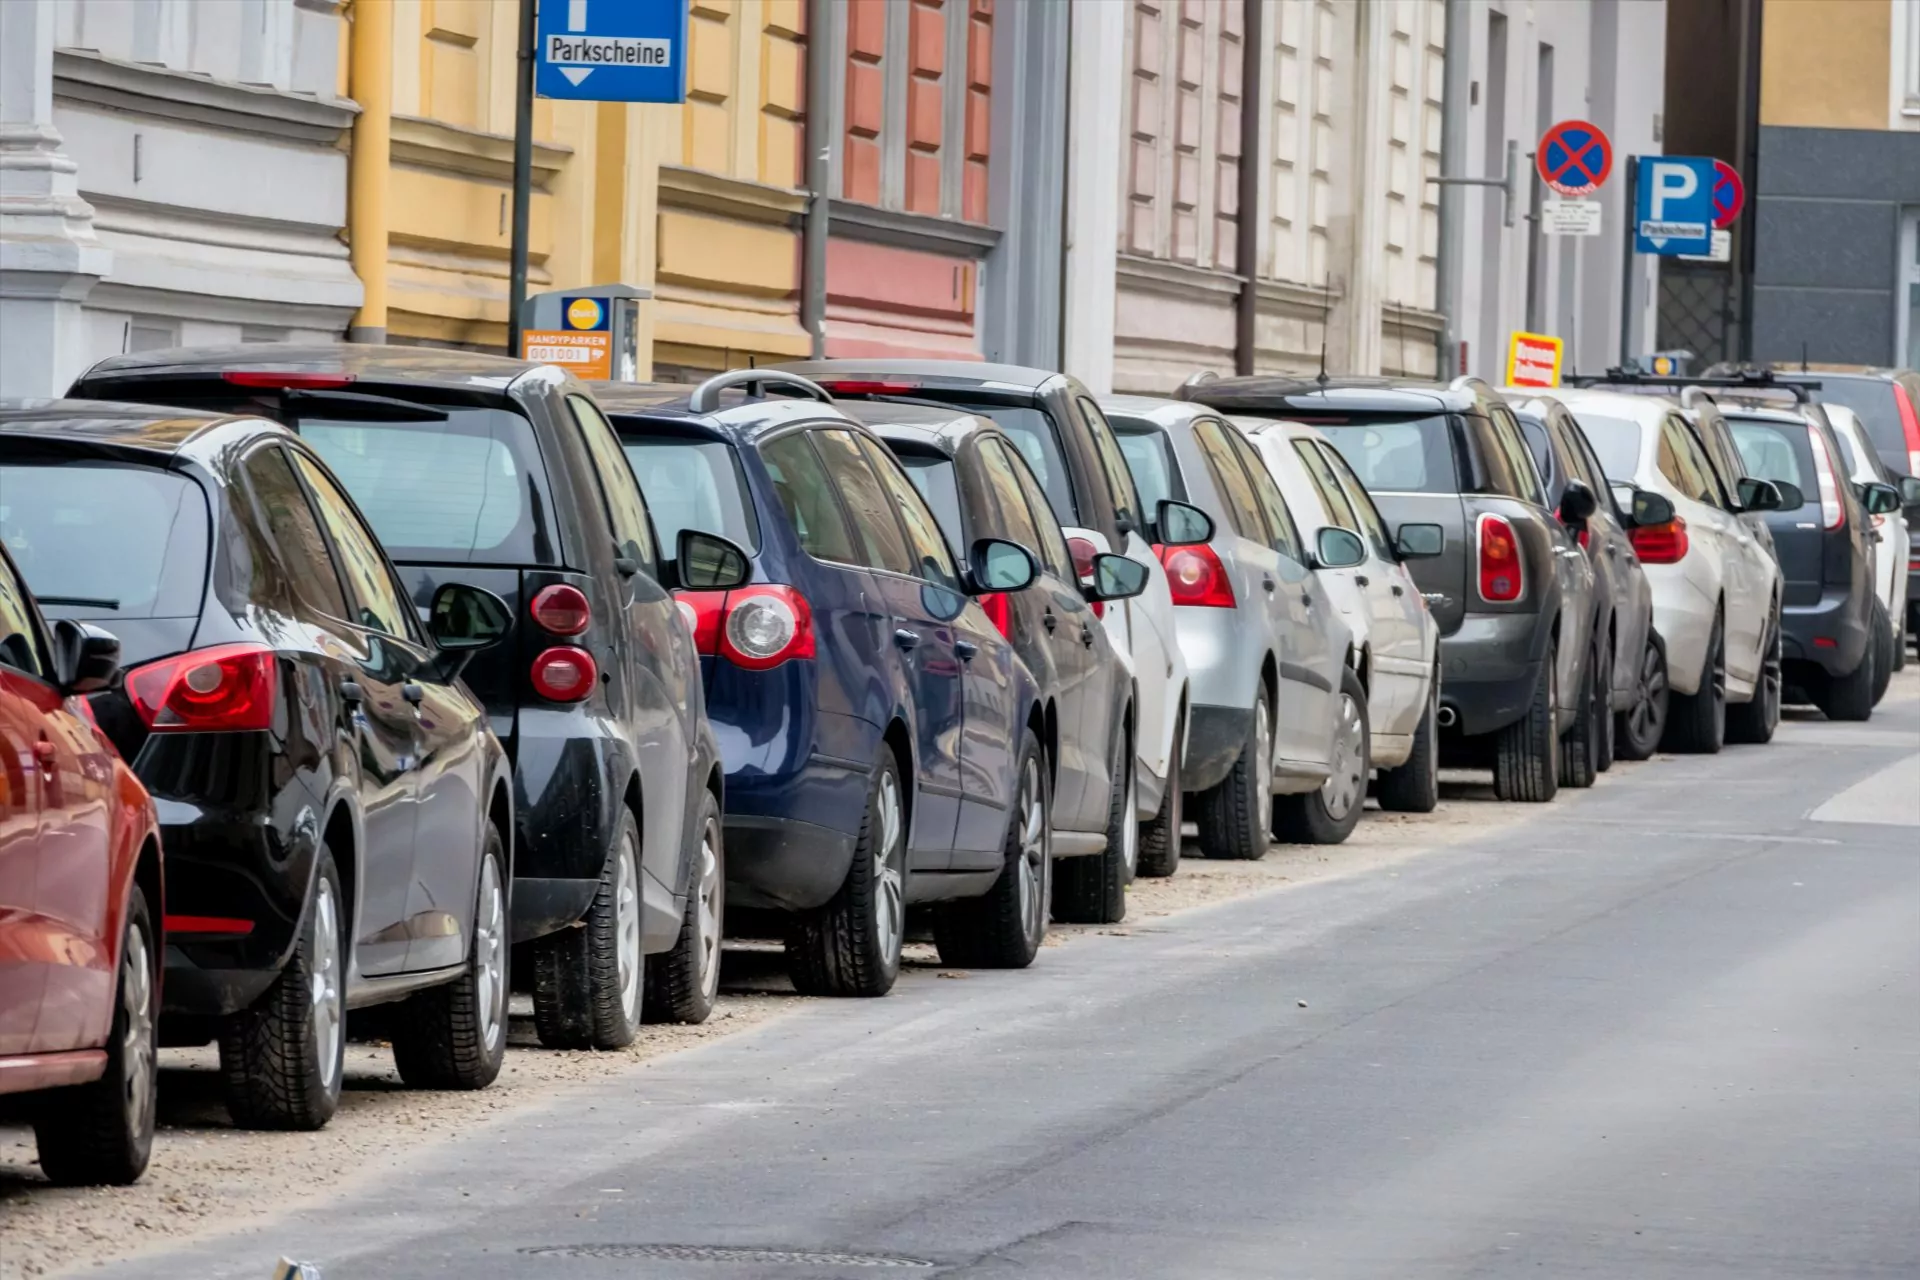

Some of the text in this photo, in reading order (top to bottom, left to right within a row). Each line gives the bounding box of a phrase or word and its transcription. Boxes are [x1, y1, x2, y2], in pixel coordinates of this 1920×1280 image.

[552, 38, 665, 64] Parkscheine
[1651, 163, 1698, 220] P
[1643, 223, 1703, 237] Parkscheine
[528, 335, 606, 346] HANDYPARKEN
